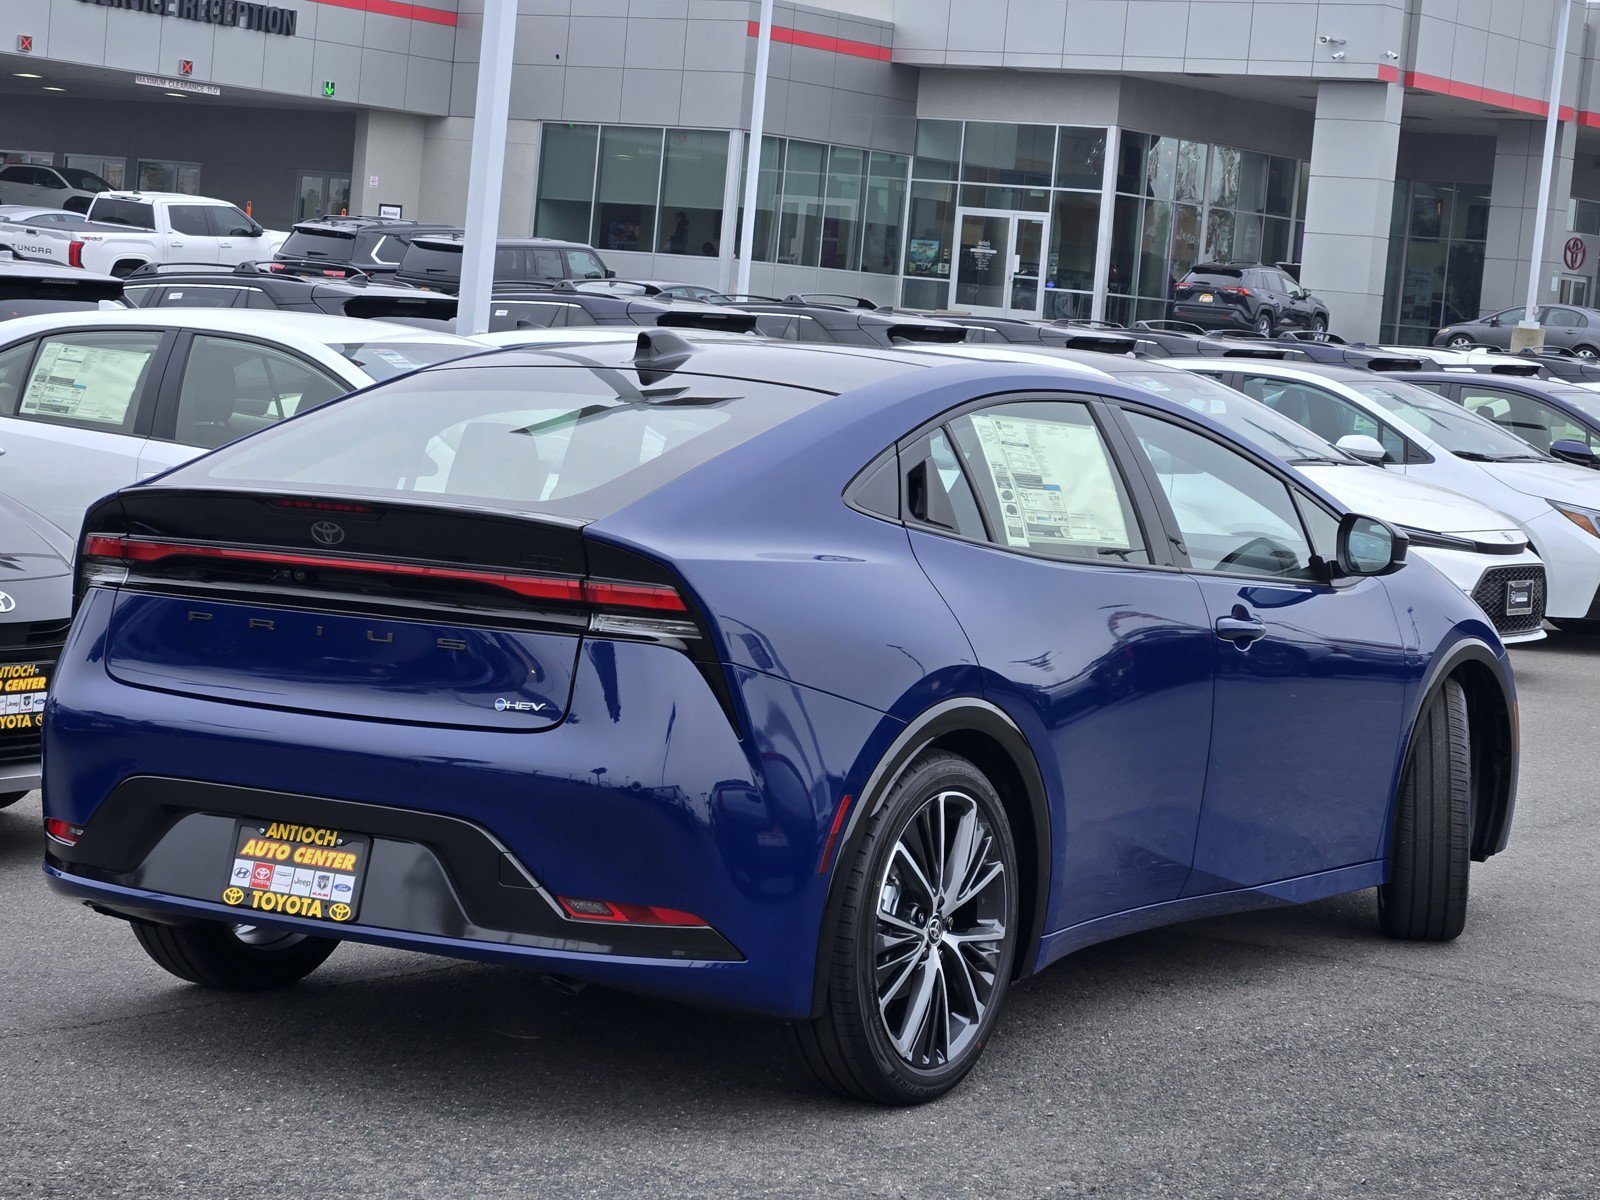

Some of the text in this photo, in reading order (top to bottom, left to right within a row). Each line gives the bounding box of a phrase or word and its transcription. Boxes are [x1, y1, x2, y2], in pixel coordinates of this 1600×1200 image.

[177, 0, 298, 36] RECEPTION
[136, 75, 167, 87] MAXIMUM
[168, 80, 205, 93] CLEARANCE
[1176, 228, 1196, 244] Jeep
[11, 243, 53, 255] TUNDRA
[188, 611, 467, 650] PRIUS
[5, 676, 47, 692] CENTER
[505, 700, 546, 712] HEV
[265, 822, 338, 847] ANTIOCH
[240, 838, 357, 872] AUTO CENTER
[251, 878, 270, 886] TOYOTA
[293, 876, 311, 888] Jeep
[252, 890, 323, 918] TOYOTA
